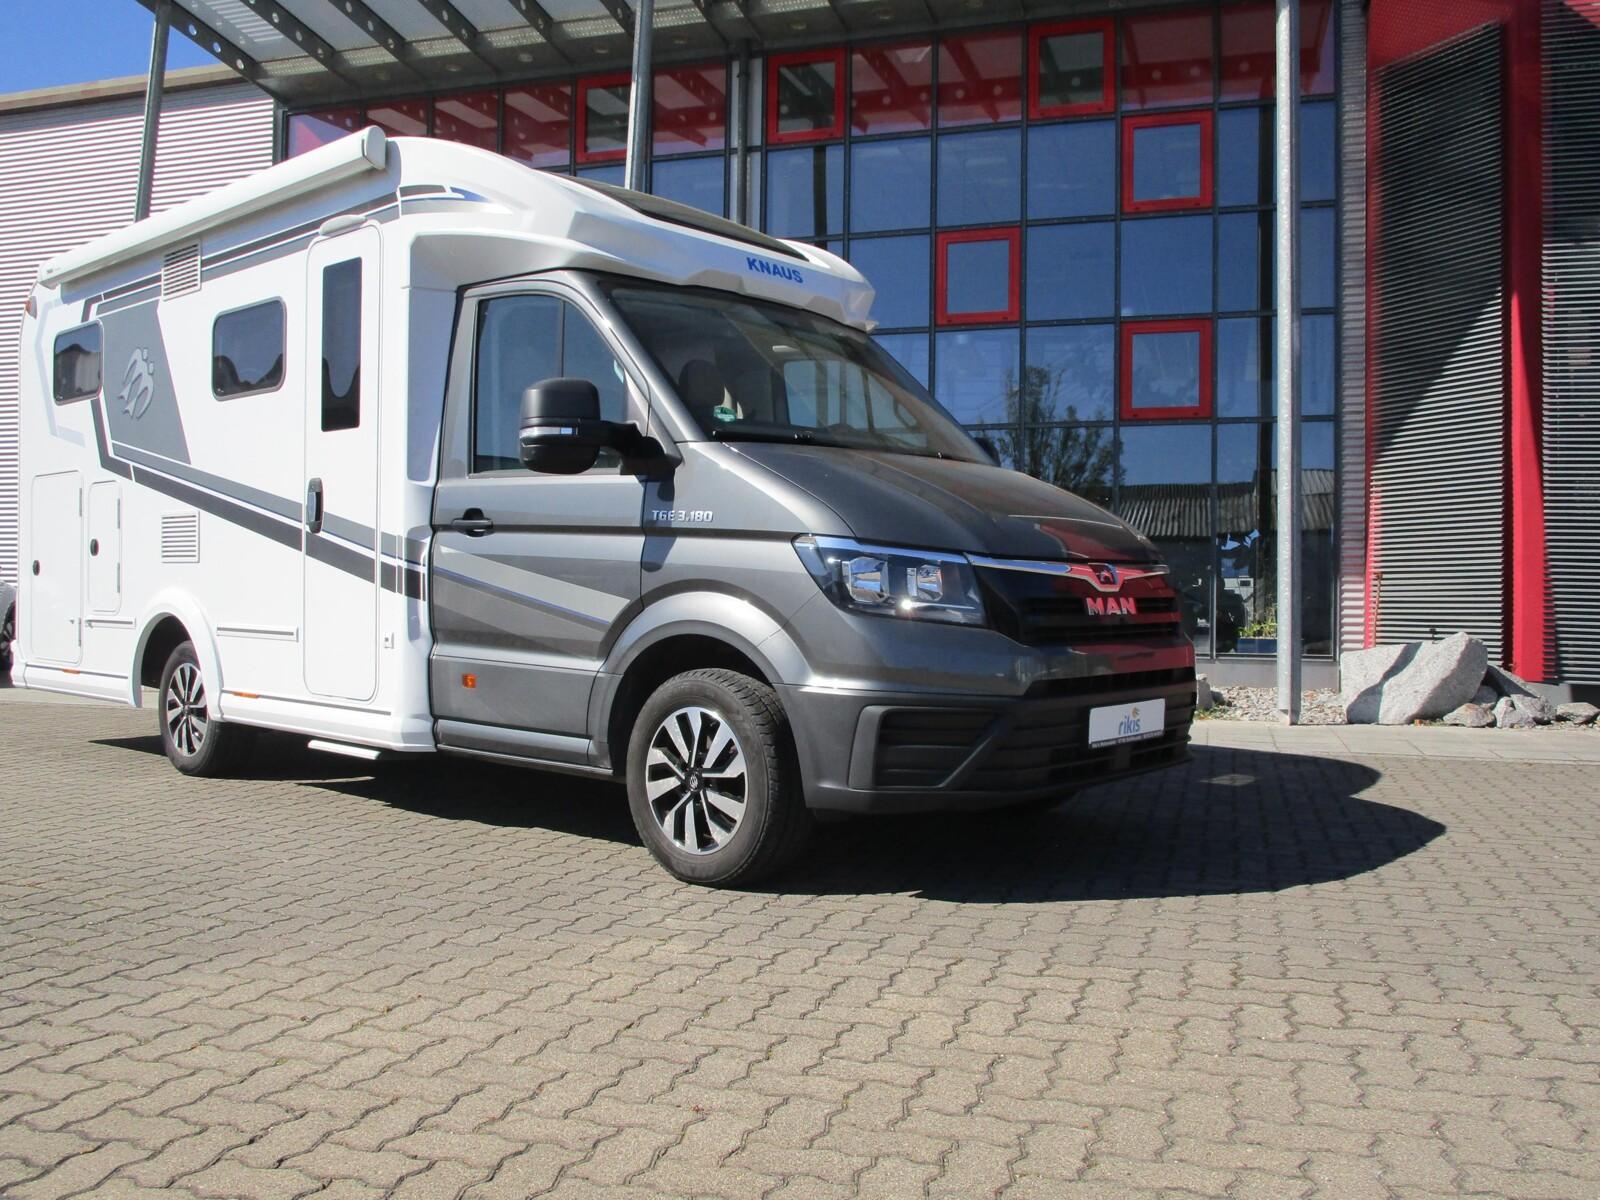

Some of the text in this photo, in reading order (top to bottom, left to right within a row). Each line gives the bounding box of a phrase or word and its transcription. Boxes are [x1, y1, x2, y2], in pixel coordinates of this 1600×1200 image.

[746, 257, 803, 283] KNAUS
[652, 505, 713, 522] TGE 3.180
[1086, 597, 1137, 616] MAN
[1118, 715, 1140, 735] rikis
